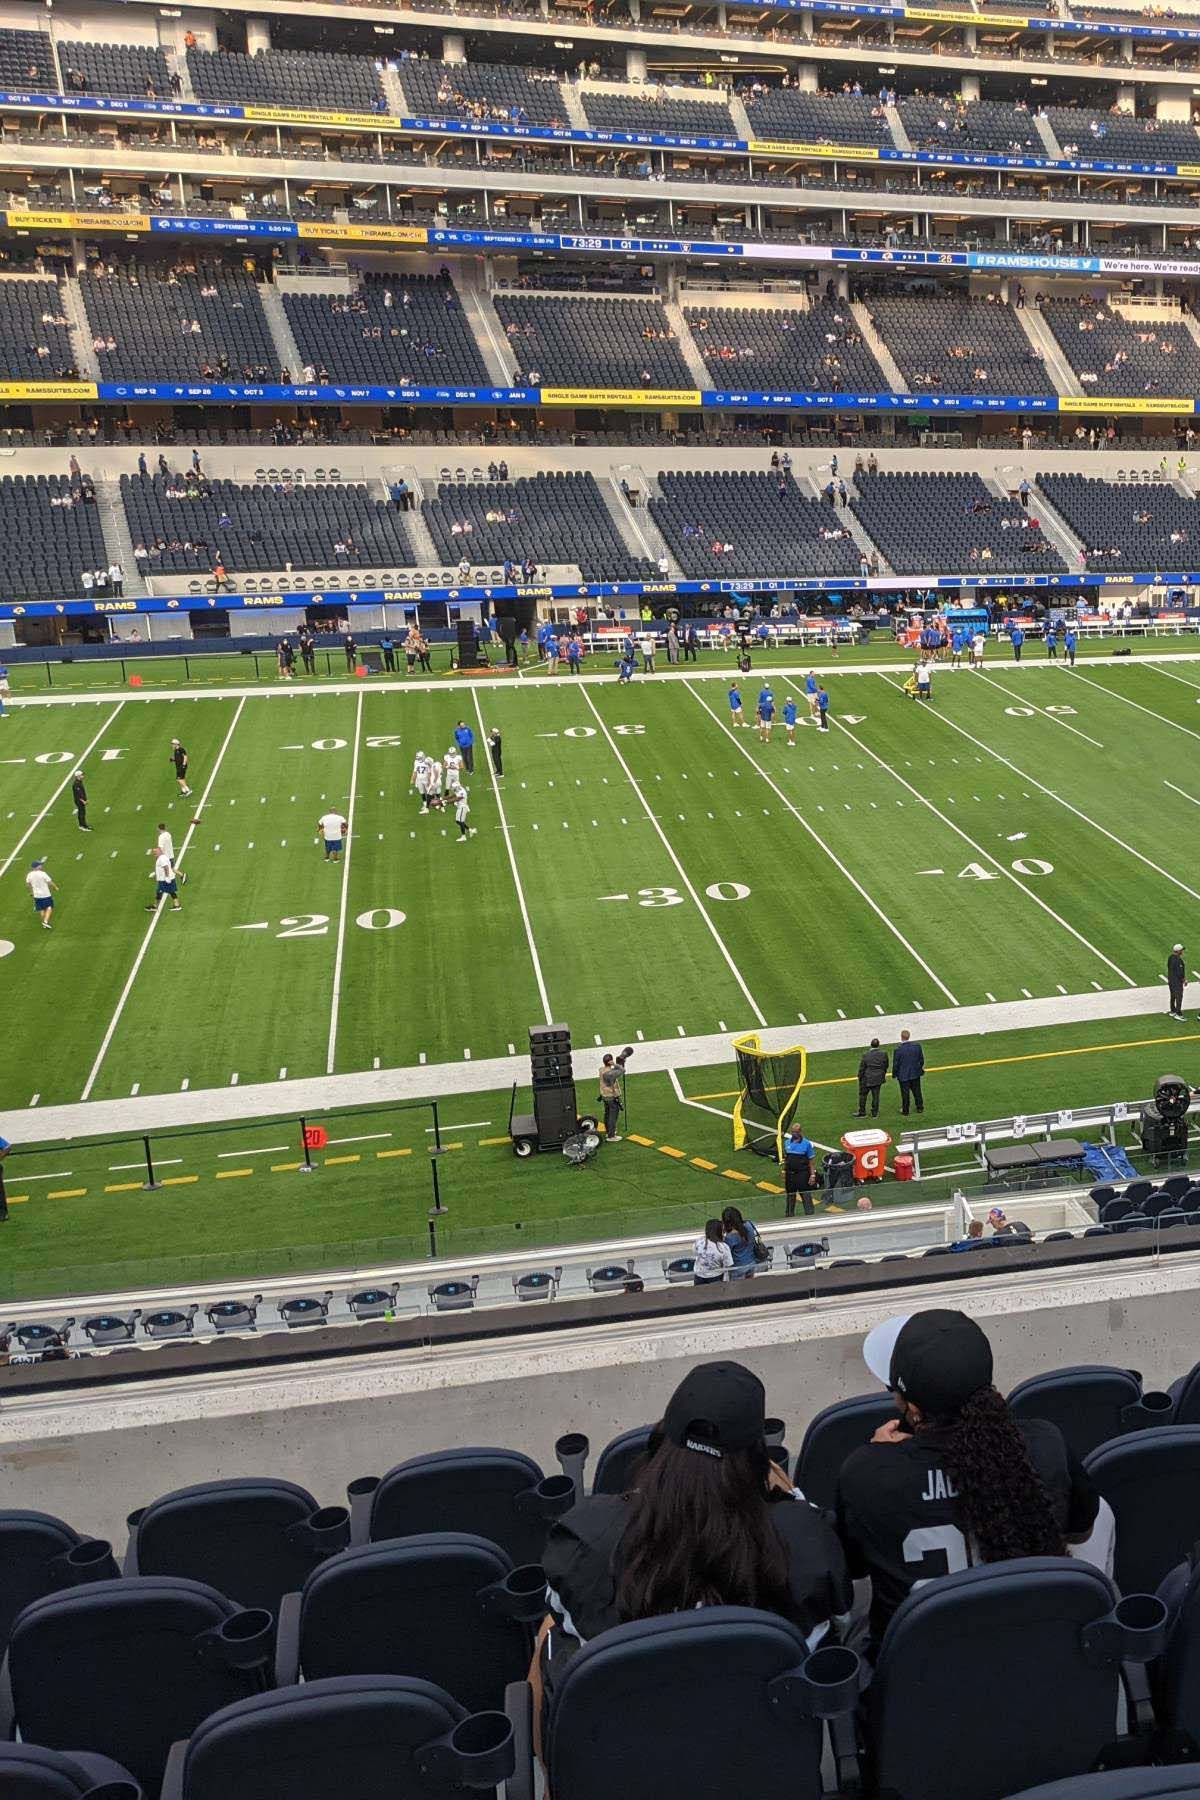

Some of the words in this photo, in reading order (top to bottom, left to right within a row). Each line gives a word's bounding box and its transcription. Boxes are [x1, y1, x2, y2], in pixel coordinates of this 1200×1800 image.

[572, 238, 602, 248] 73:29
[976, 256, 1079, 268] #RAMSHOUSE
[1104, 261, 1126, 269] We're
[1130, 262, 1152, 270] here.
[1155, 263, 1178, 271] We're
[517, 588, 552, 596] RAMS
[643, 584, 676, 592] RAMS
[384, 591, 422, 600] RAMS
[244, 596, 283, 605] RAMS
[95, 602, 137, 611] RAMS
[304, 1130, 321, 1146] 20
[861, 1150, 879, 1169] G
